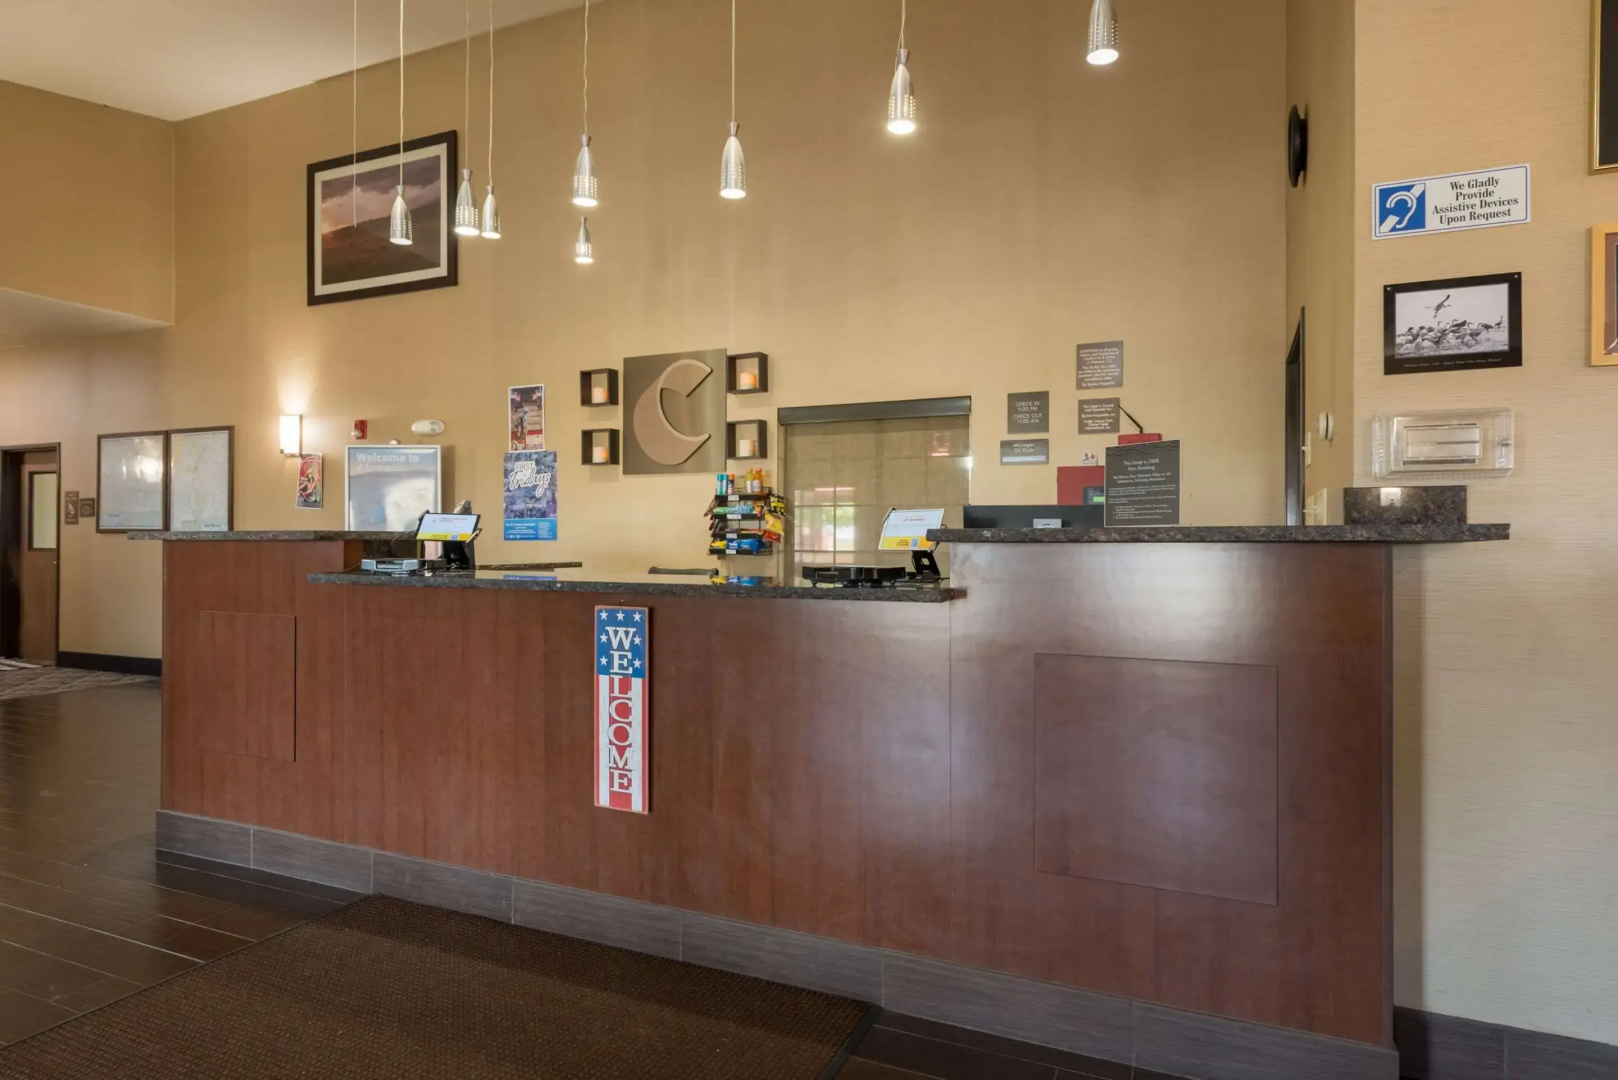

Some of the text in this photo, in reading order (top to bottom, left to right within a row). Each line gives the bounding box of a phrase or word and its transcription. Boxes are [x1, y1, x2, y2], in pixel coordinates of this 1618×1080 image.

[1450, 177, 1500, 190] We Gladly
[1456, 189, 1495, 201] Provide
[1432, 197, 1519, 215] Assistive Devices
[1439, 208, 1512, 225] Upon Request
[357, 453, 420, 462] Welcome to
[516, 462, 533, 470] FIRST
[510, 468, 551, 496] Fridays
[605, 626, 636, 794] WELCOME
